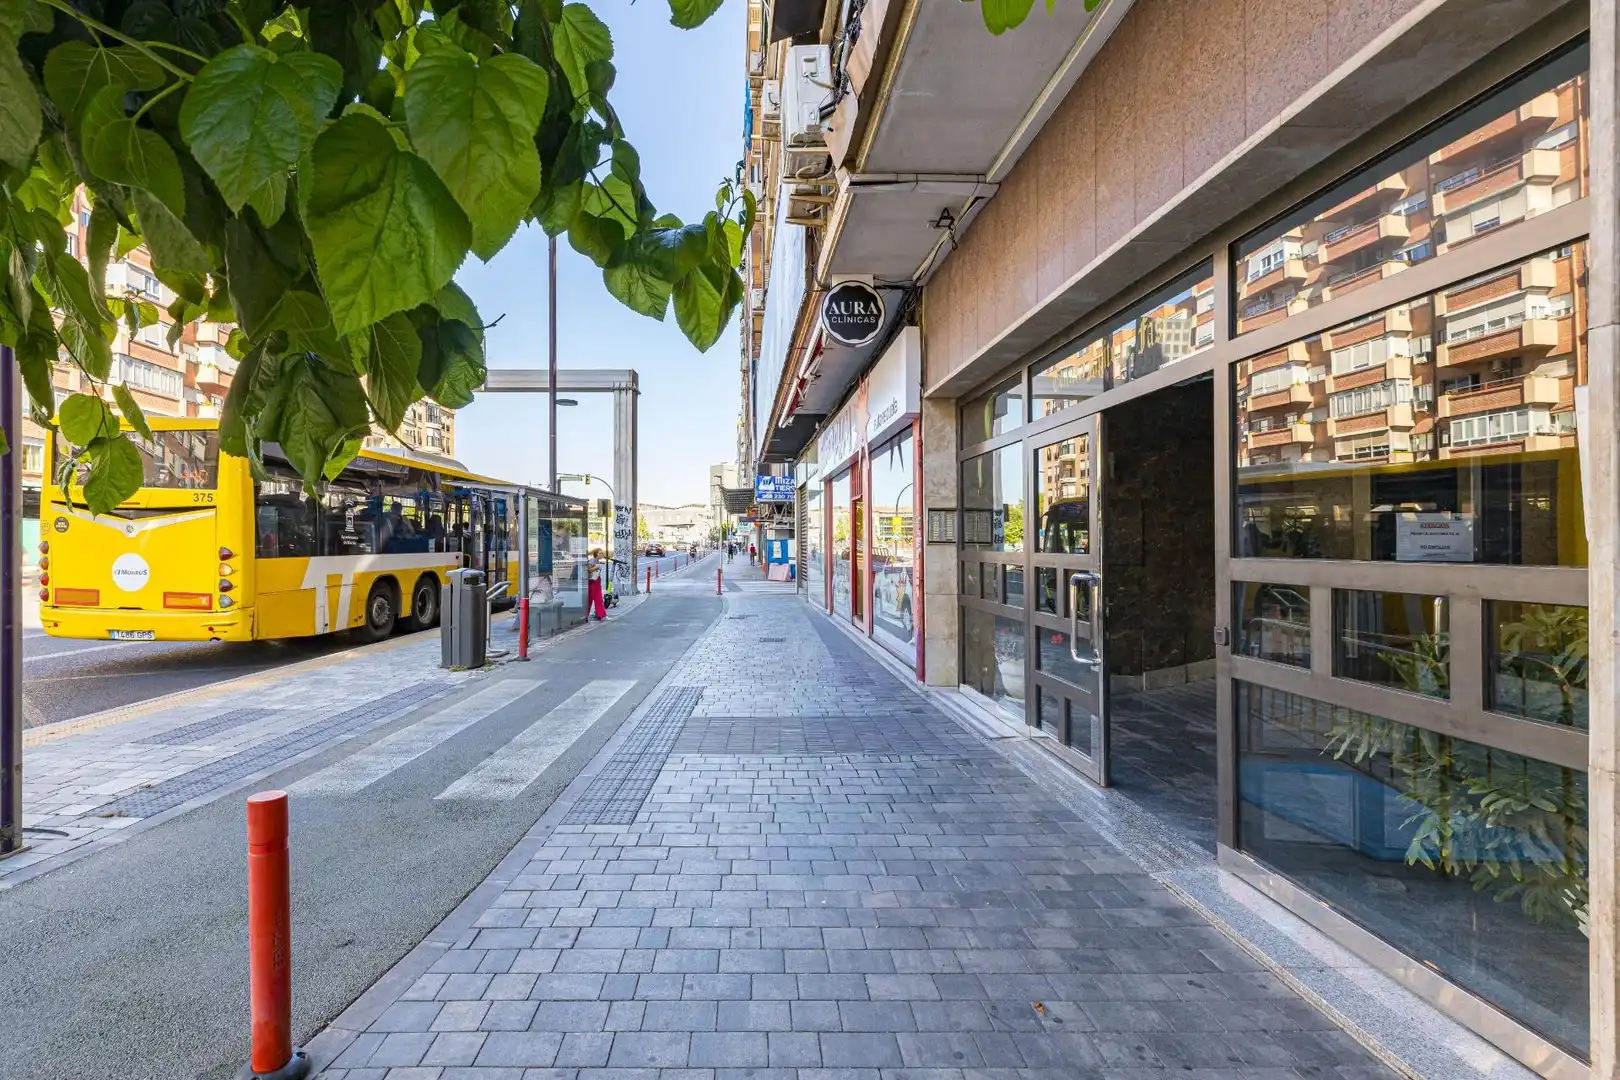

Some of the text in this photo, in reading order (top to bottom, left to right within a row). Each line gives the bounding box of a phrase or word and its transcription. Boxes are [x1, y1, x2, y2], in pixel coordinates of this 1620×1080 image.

[829, 301, 879, 315] AURA
[193, 493, 213, 502] 375
[137, 631, 153, 639] GPS
